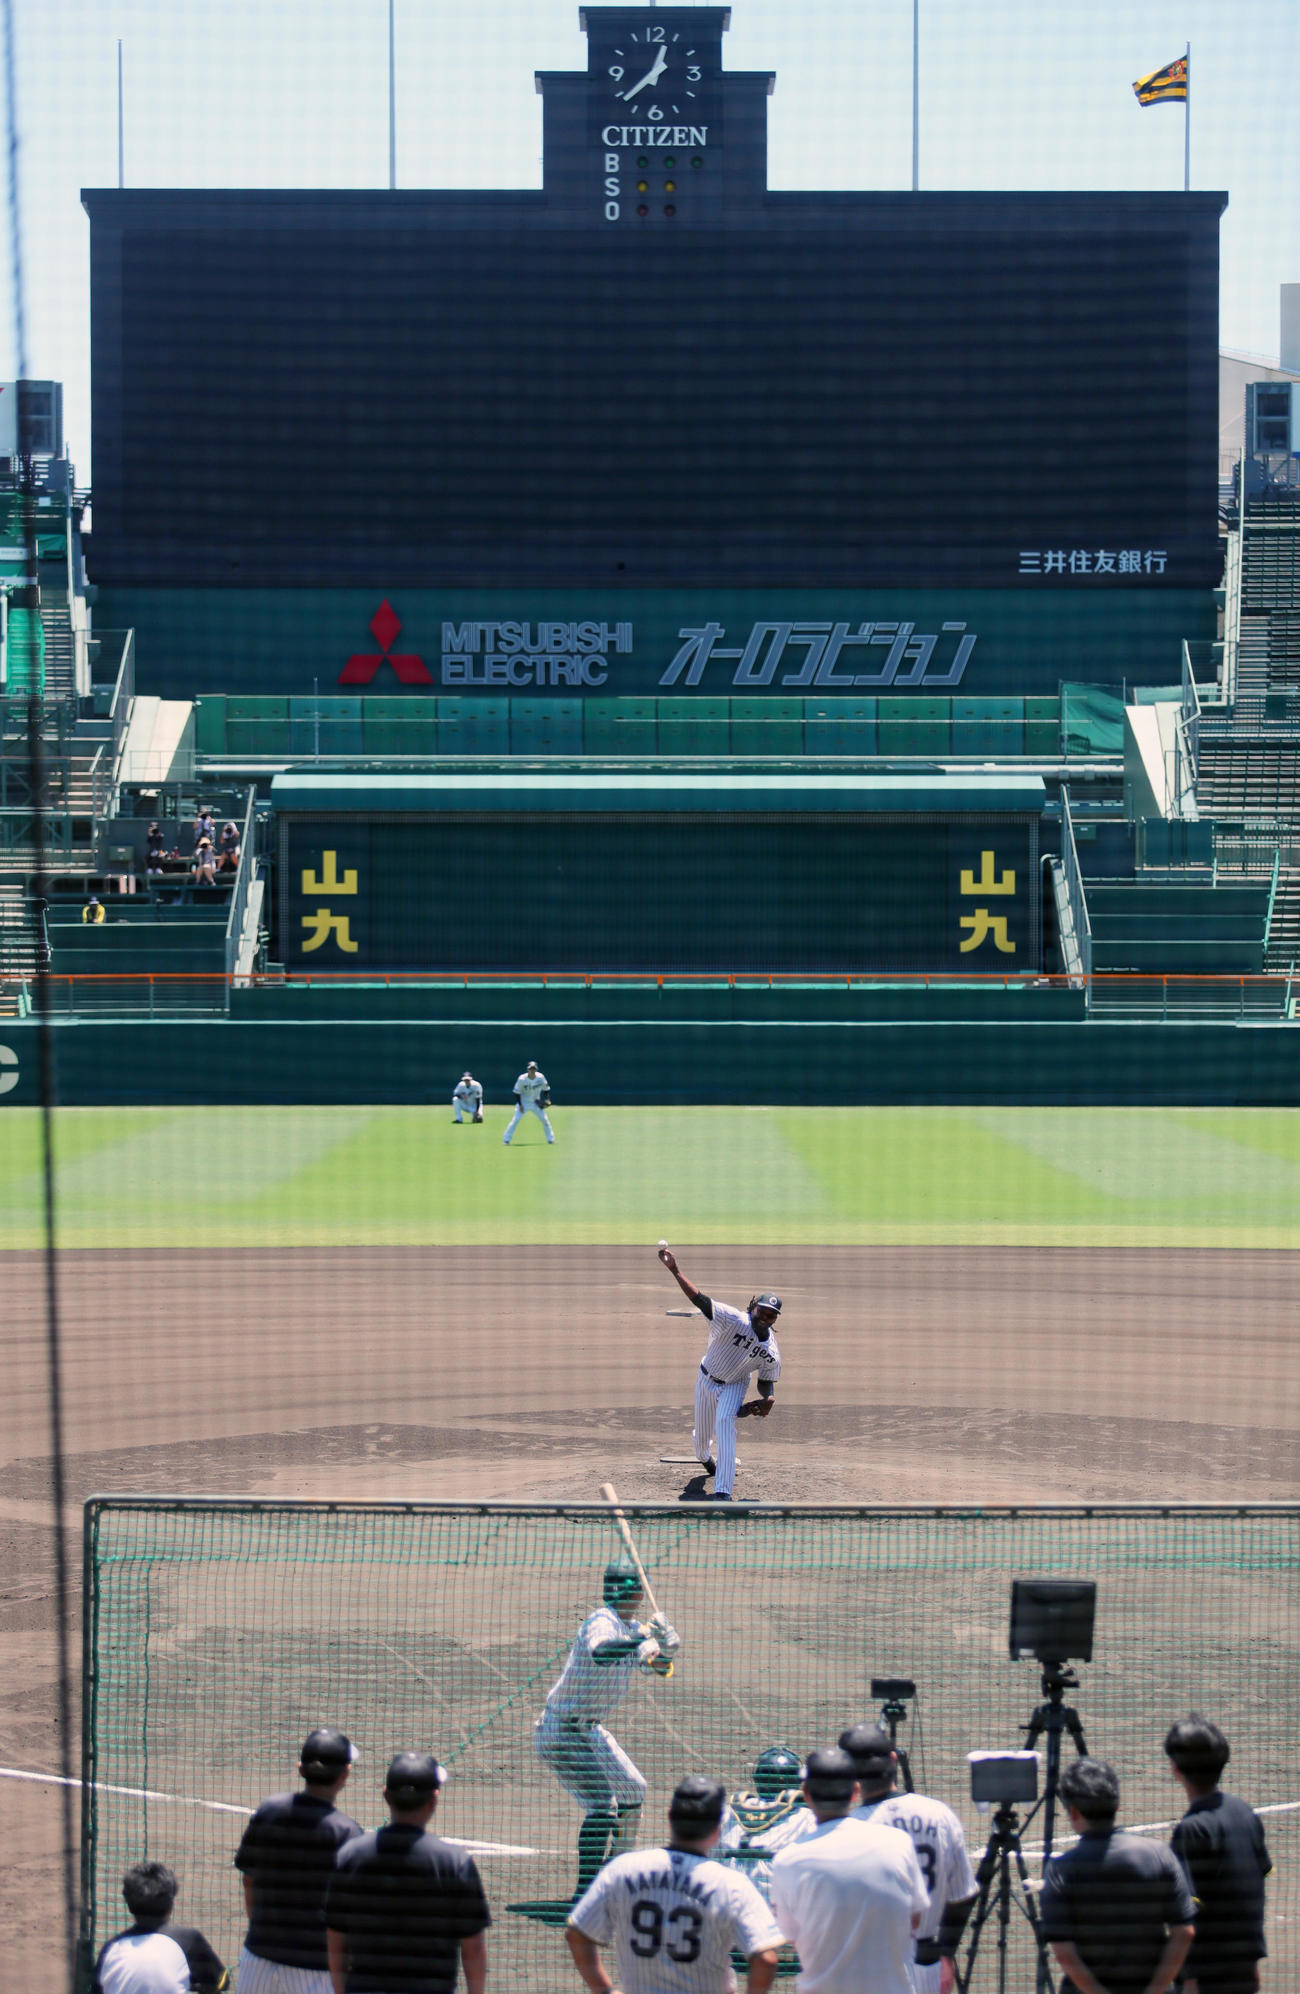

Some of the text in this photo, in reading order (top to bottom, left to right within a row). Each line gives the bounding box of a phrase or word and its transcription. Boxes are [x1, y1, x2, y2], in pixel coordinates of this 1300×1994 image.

[646, 27, 665, 42] 12
[608, 66, 624, 81] 9
[686, 66, 702, 81] 3
[647, 105, 664, 121] 6
[602, 126, 708, 146] CITIZEN
[605, 153, 620, 172] B
[605, 177, 620, 196] S
[1018, 549, 1168, 573] 三井住友銀行
[441, 621, 633, 653] MITSUBISHI
[658, 622, 977, 686] オーロラビジョン
[441, 654, 608, 686] ELECTRIC
[302, 850, 358, 953] 山九
[960, 850, 1016, 953] 山九
[733, 1333, 776, 1363] Tigers
[630, 1899, 703, 1963] 93
